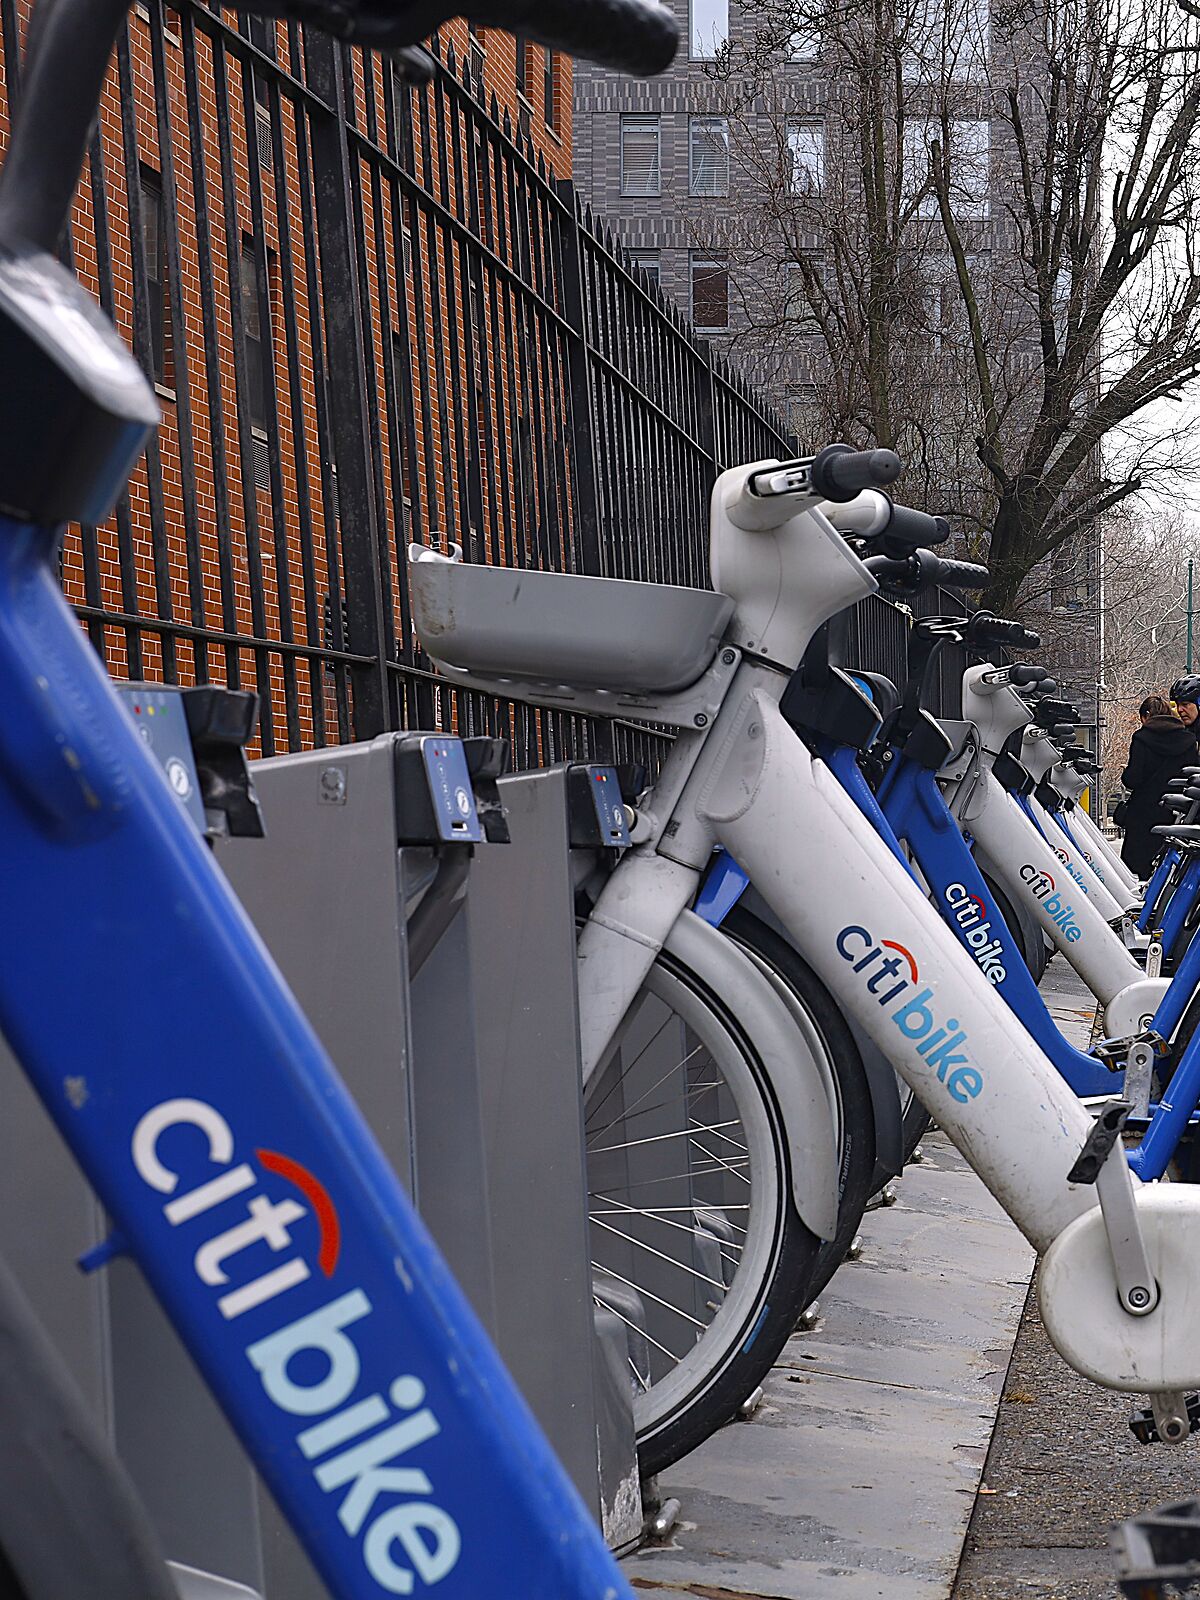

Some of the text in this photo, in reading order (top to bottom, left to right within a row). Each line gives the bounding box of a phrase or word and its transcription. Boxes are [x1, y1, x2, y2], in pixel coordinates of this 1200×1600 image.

[945, 883, 1006, 985] citi bike
[1019, 864, 1081, 942] citi bike
[836, 925, 983, 1104] citi bike
[132, 1098, 461, 1595] citi bike
